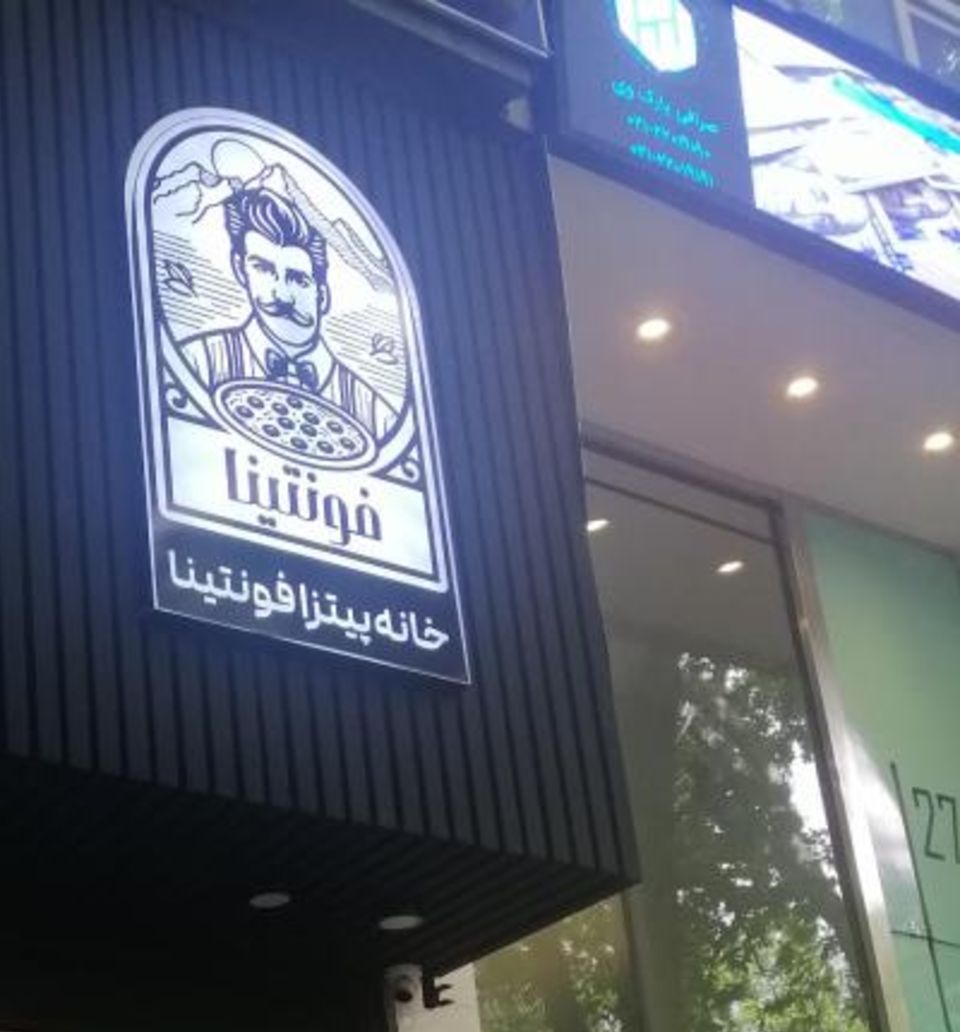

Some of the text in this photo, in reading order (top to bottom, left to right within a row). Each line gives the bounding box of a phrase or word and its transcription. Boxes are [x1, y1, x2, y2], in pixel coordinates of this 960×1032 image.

[225, 447, 382, 546] فونتینا
[168, 549, 449, 650] خانه پیتزا فونتینا
